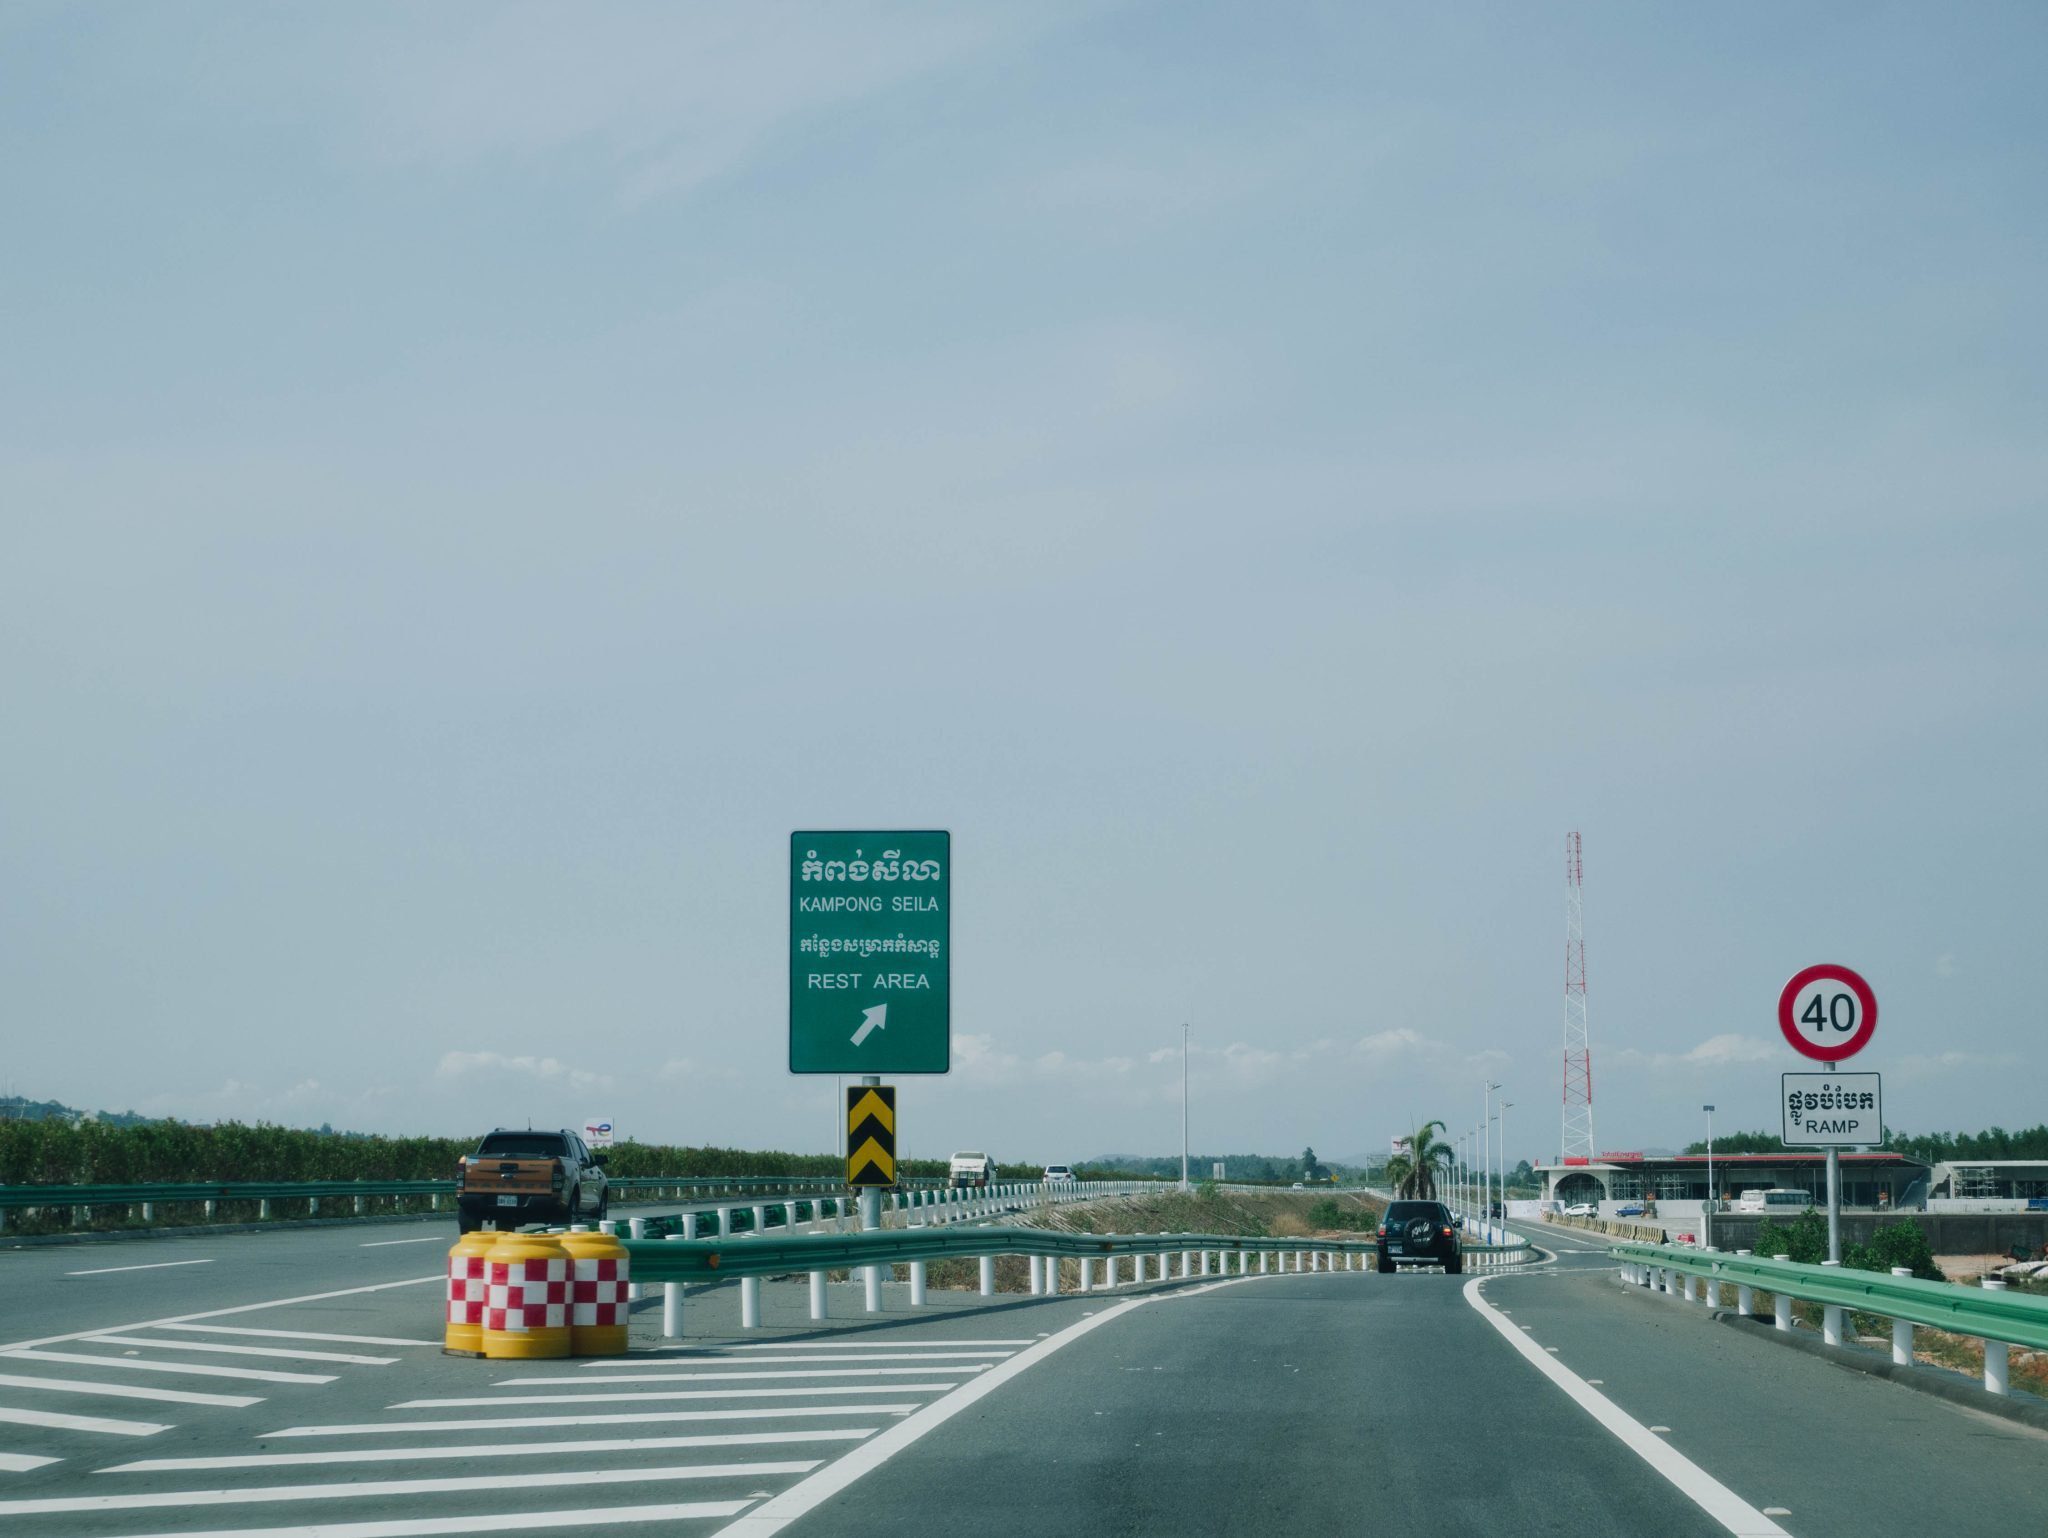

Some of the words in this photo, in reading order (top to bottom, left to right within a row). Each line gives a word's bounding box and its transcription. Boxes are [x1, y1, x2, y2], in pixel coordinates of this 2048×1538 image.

[801, 849, 940, 881] កំពង់សីលា
[800, 896, 882, 912] KAMPONG
[892, 896, 939, 912] SEILA
[808, 973, 862, 989] REST
[873, 973, 930, 989] AREA
[1800, 993, 1855, 1032] 40
[1806, 1119, 1859, 1134] RAMP
